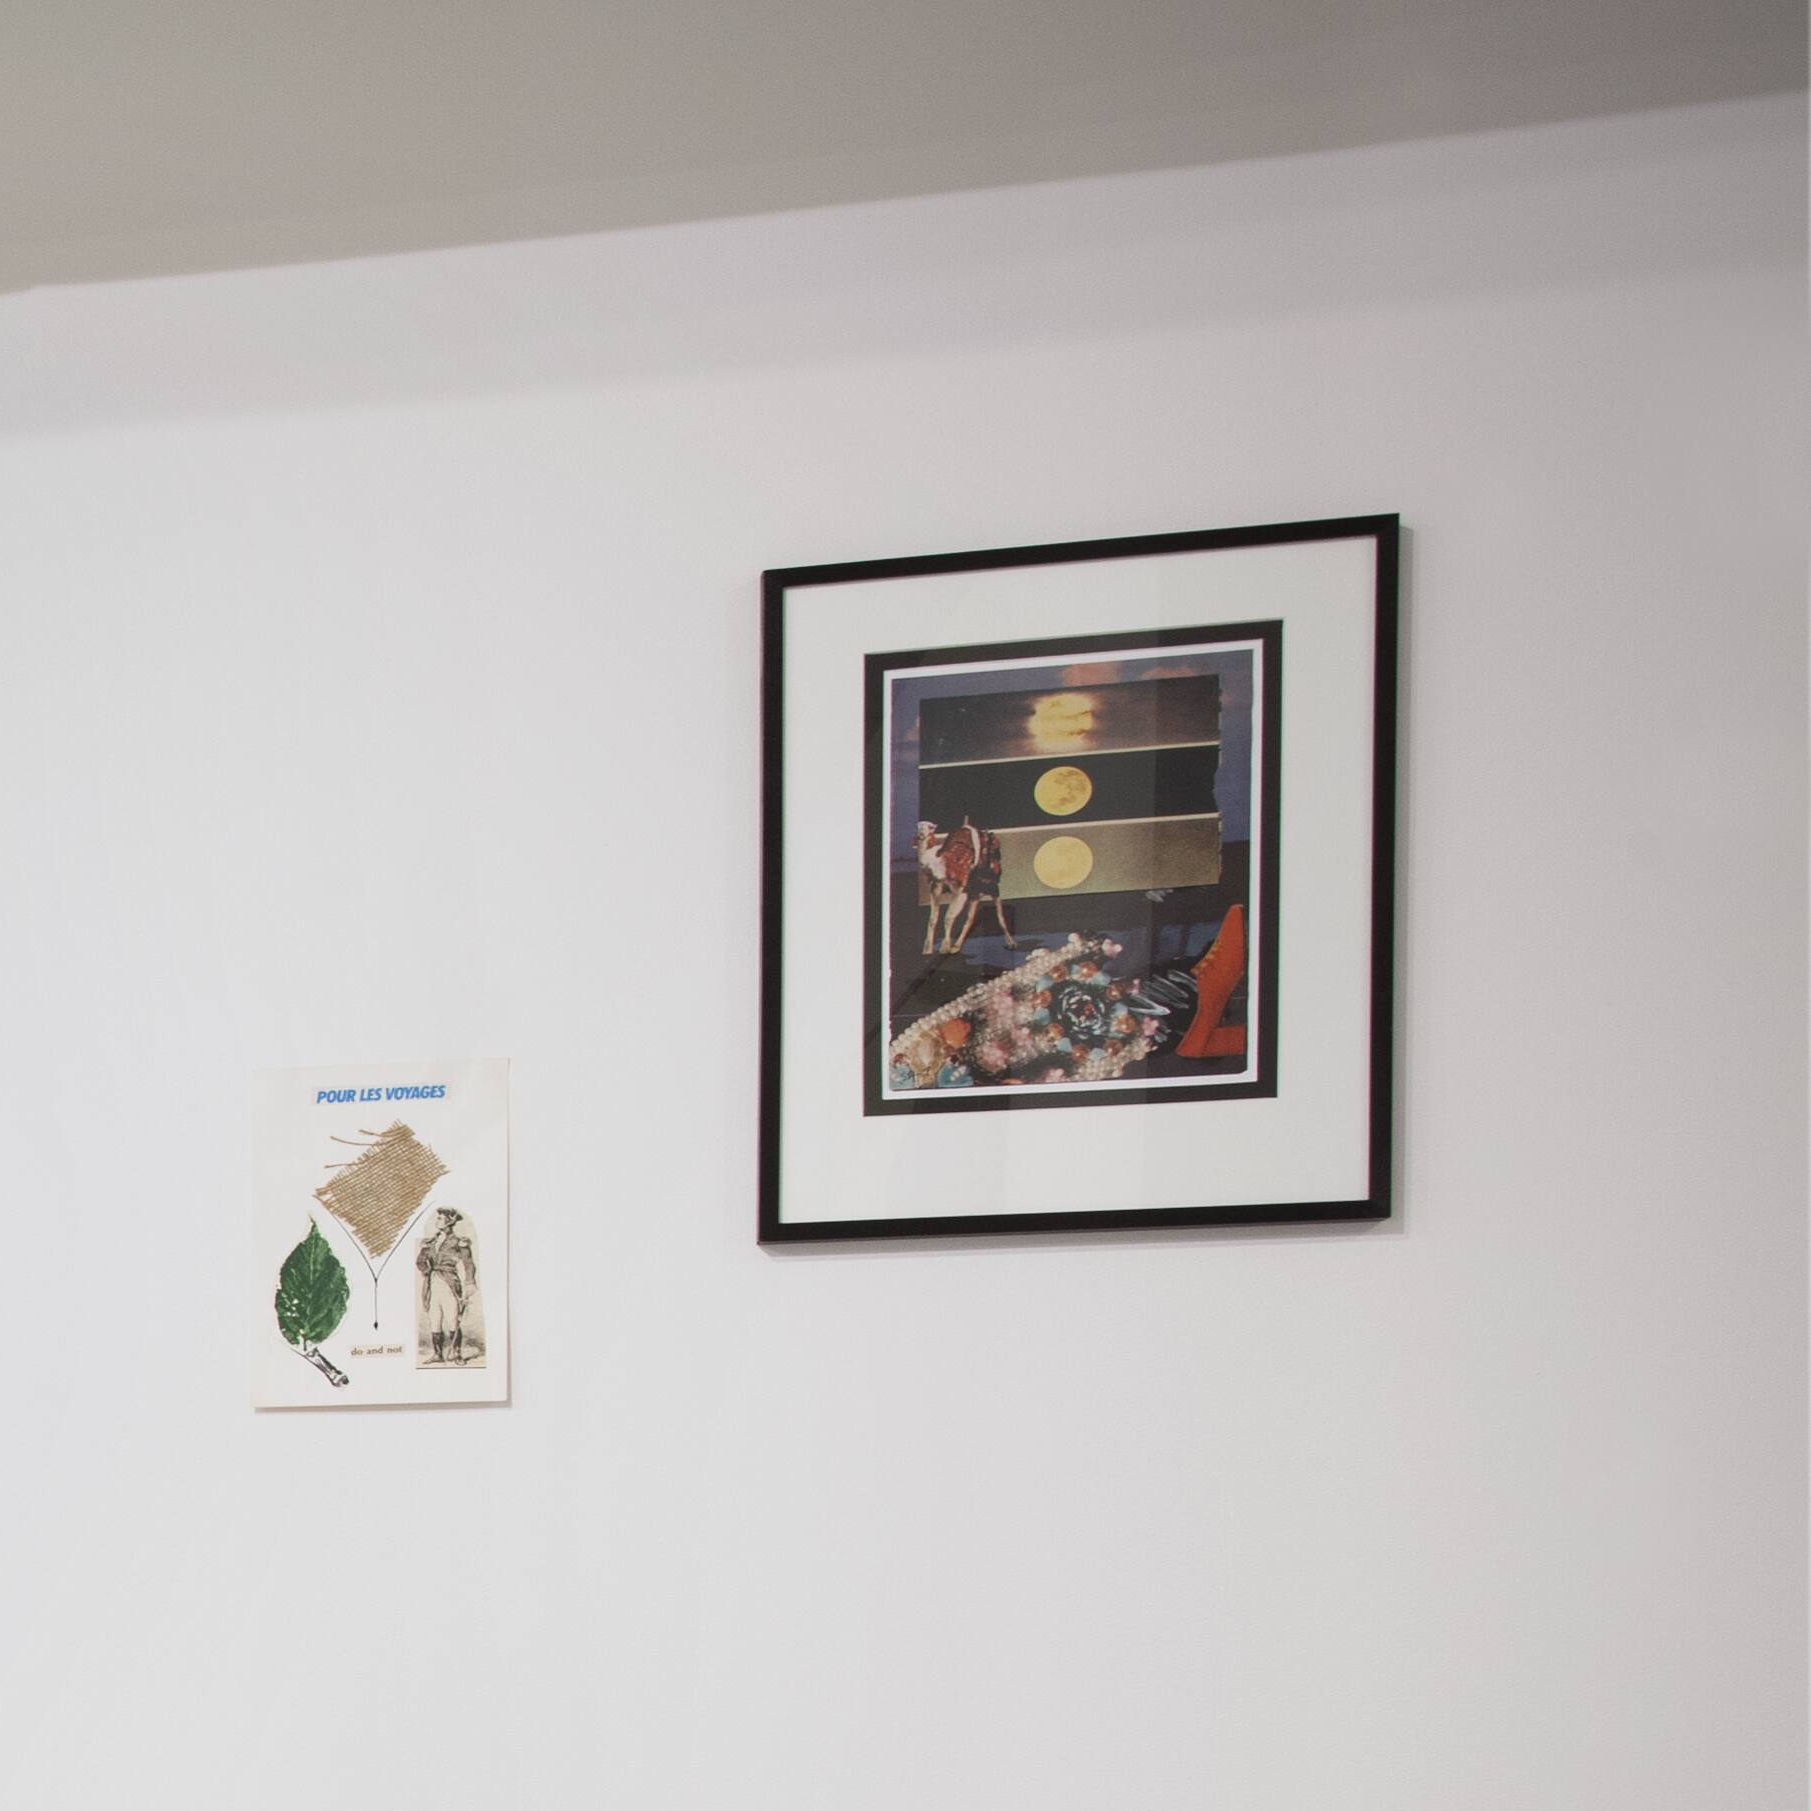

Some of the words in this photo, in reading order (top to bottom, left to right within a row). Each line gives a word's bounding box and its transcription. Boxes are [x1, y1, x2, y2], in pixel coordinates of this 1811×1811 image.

[317, 1089, 356, 1103] POUR
[360, 1088, 382, 1102] LES
[385, 1085, 446, 1099] VOYAGES
[366, 1345, 383, 1354] and
